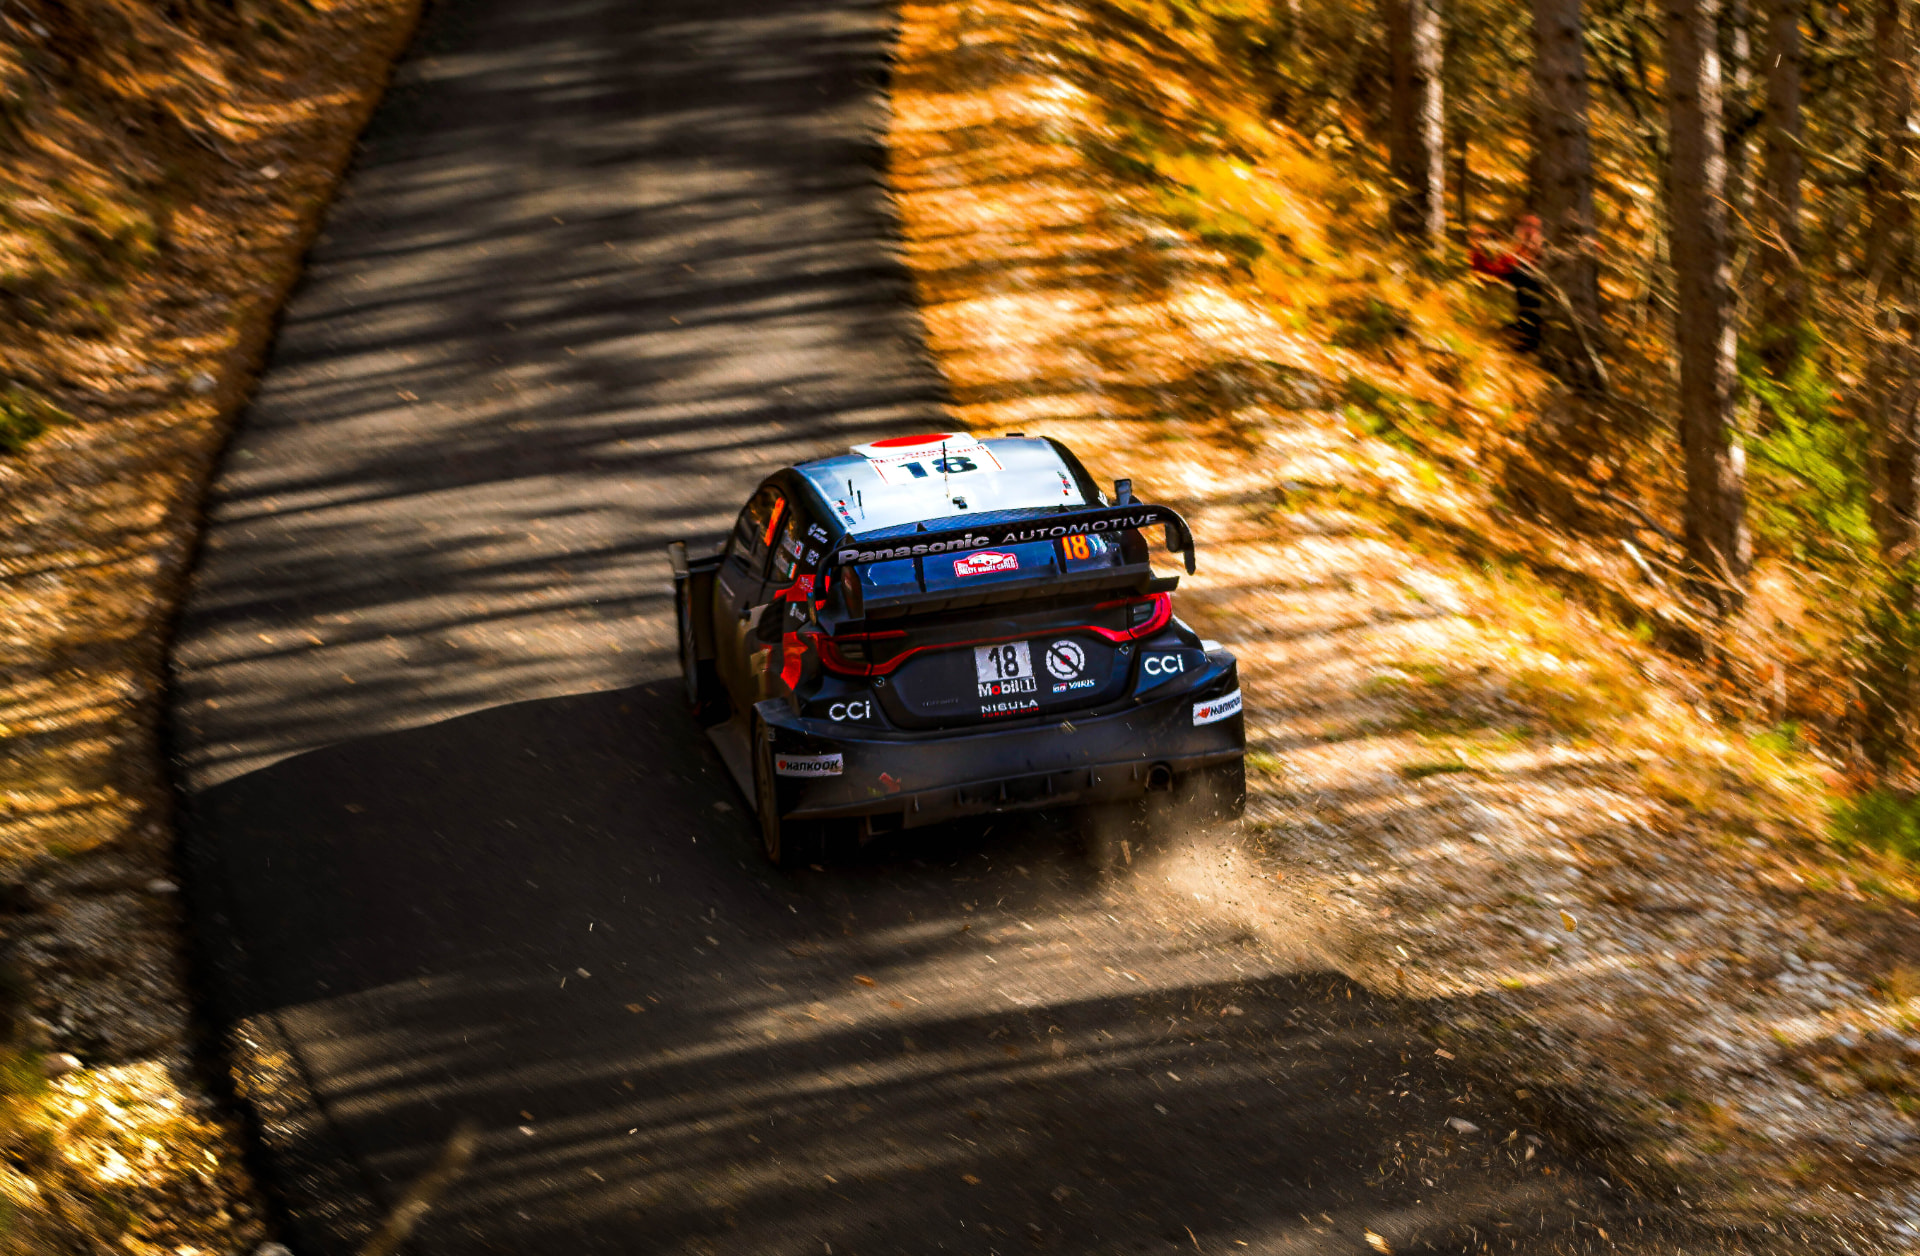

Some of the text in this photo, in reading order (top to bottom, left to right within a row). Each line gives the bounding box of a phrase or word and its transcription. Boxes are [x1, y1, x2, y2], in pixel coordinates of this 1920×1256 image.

[898, 456, 978, 479] 18
[838, 533, 990, 566] Panasonic
[1001, 513, 1158, 544] AUTOMOTIVE
[1061, 534, 1090, 560] 18
[988, 645, 1019, 679] 18
[978, 679, 1020, 698] Mobil
[1068, 678, 1095, 690] YARIS
